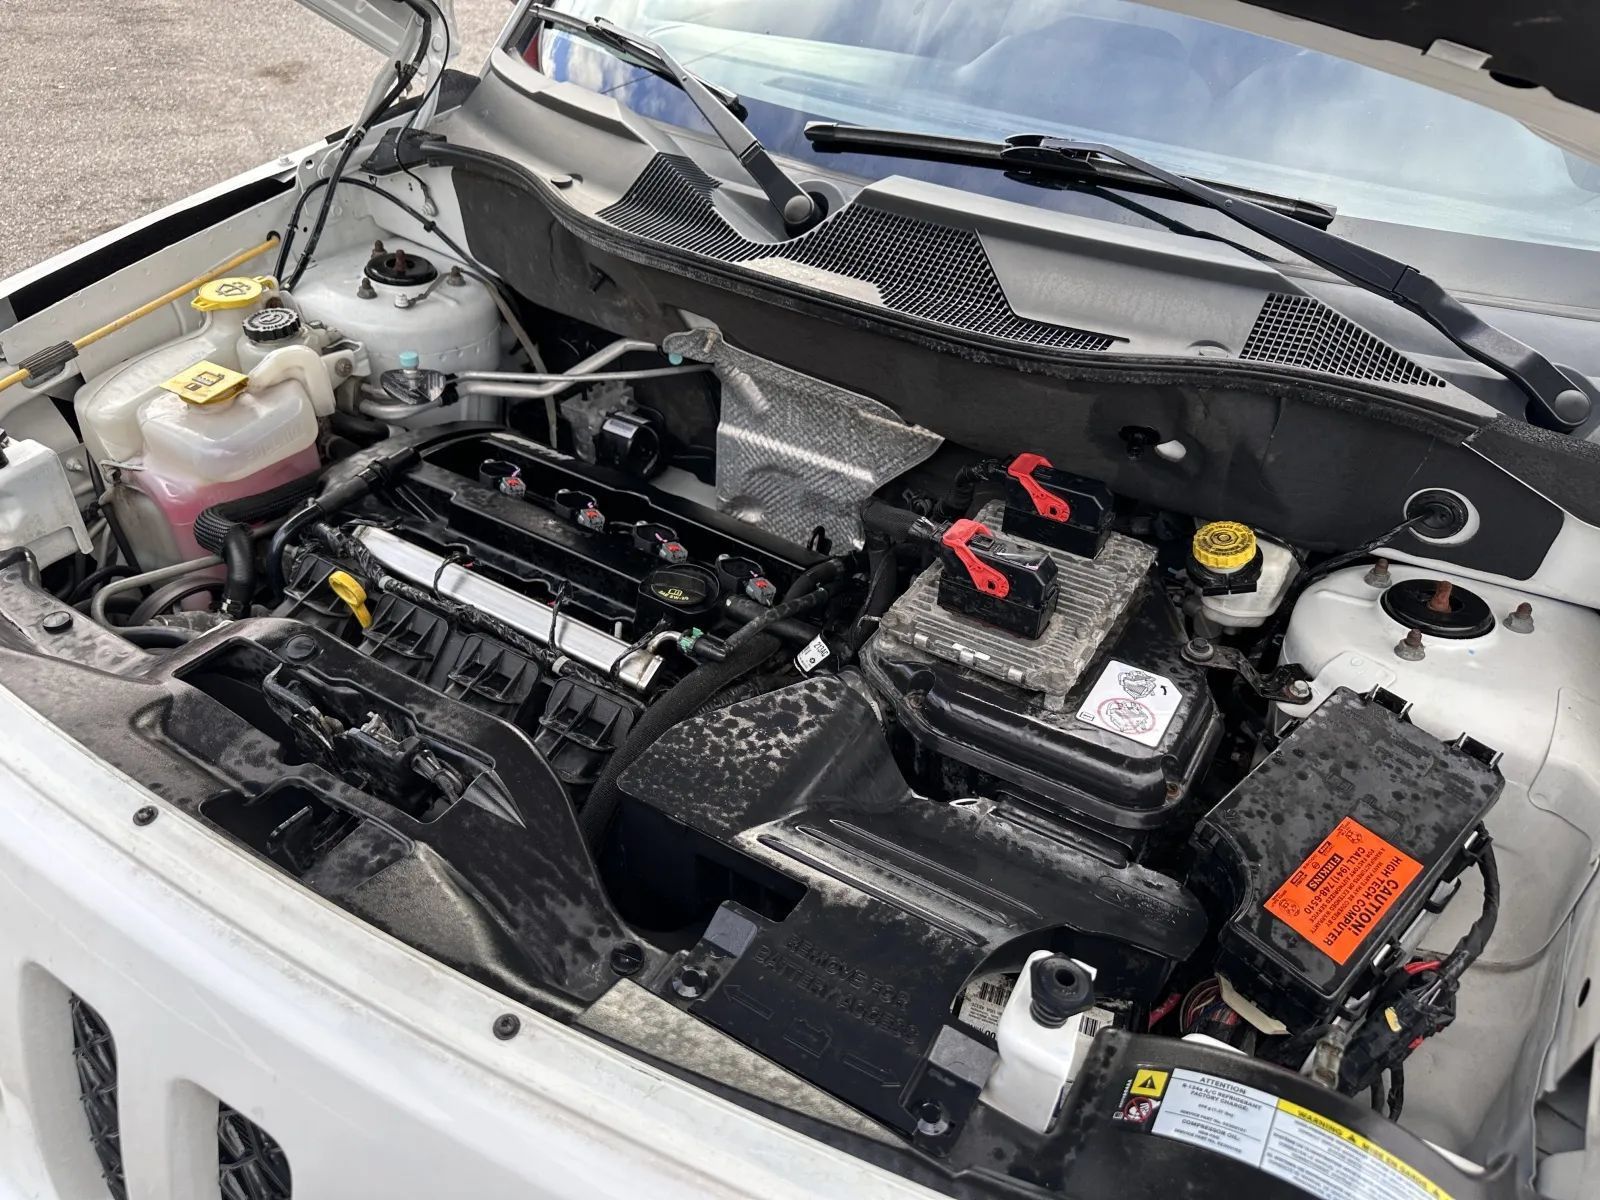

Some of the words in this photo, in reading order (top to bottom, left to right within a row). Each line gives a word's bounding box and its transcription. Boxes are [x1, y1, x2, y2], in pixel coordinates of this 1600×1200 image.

[1345, 845, 1366, 866] CALL
[1364, 848, 1374, 858] FOR
[1307, 854, 1341, 890] FIRKINS
[1329, 863, 1349, 884] (941)
[1348, 856, 1367, 877] FACTORY
[1380, 855, 1402, 877] HIGH
[1324, 875, 1351, 904] AUTHORIZED
[1351, 884, 1362, 895] MAY
[1359, 871, 1373, 886] PARTS
[1361, 876, 1384, 900] TECH
[1302, 881, 1334, 915] 748-6510
[1328, 888, 1349, 911] EXTENDED
[1347, 877, 1400, 937] CAUTION!
[1308, 902, 1327, 923] SERVICE
[1309, 909, 1331, 934] WARRANTY
[1322, 897, 1366, 946] COMPUTER
[783, 932, 869, 991] REMOVE
[752, 942, 842, 1005] BATTERY
[1190, 1089, 1219, 1101] FACTORY
[1199, 1076, 1246, 1094] ATTENTION
[1217, 1091, 1261, 1110] REFRIGERANT
[1181, 1118, 1225, 1135] COMPRESSOR
[1295, 1109, 1343, 1136] WARNING
